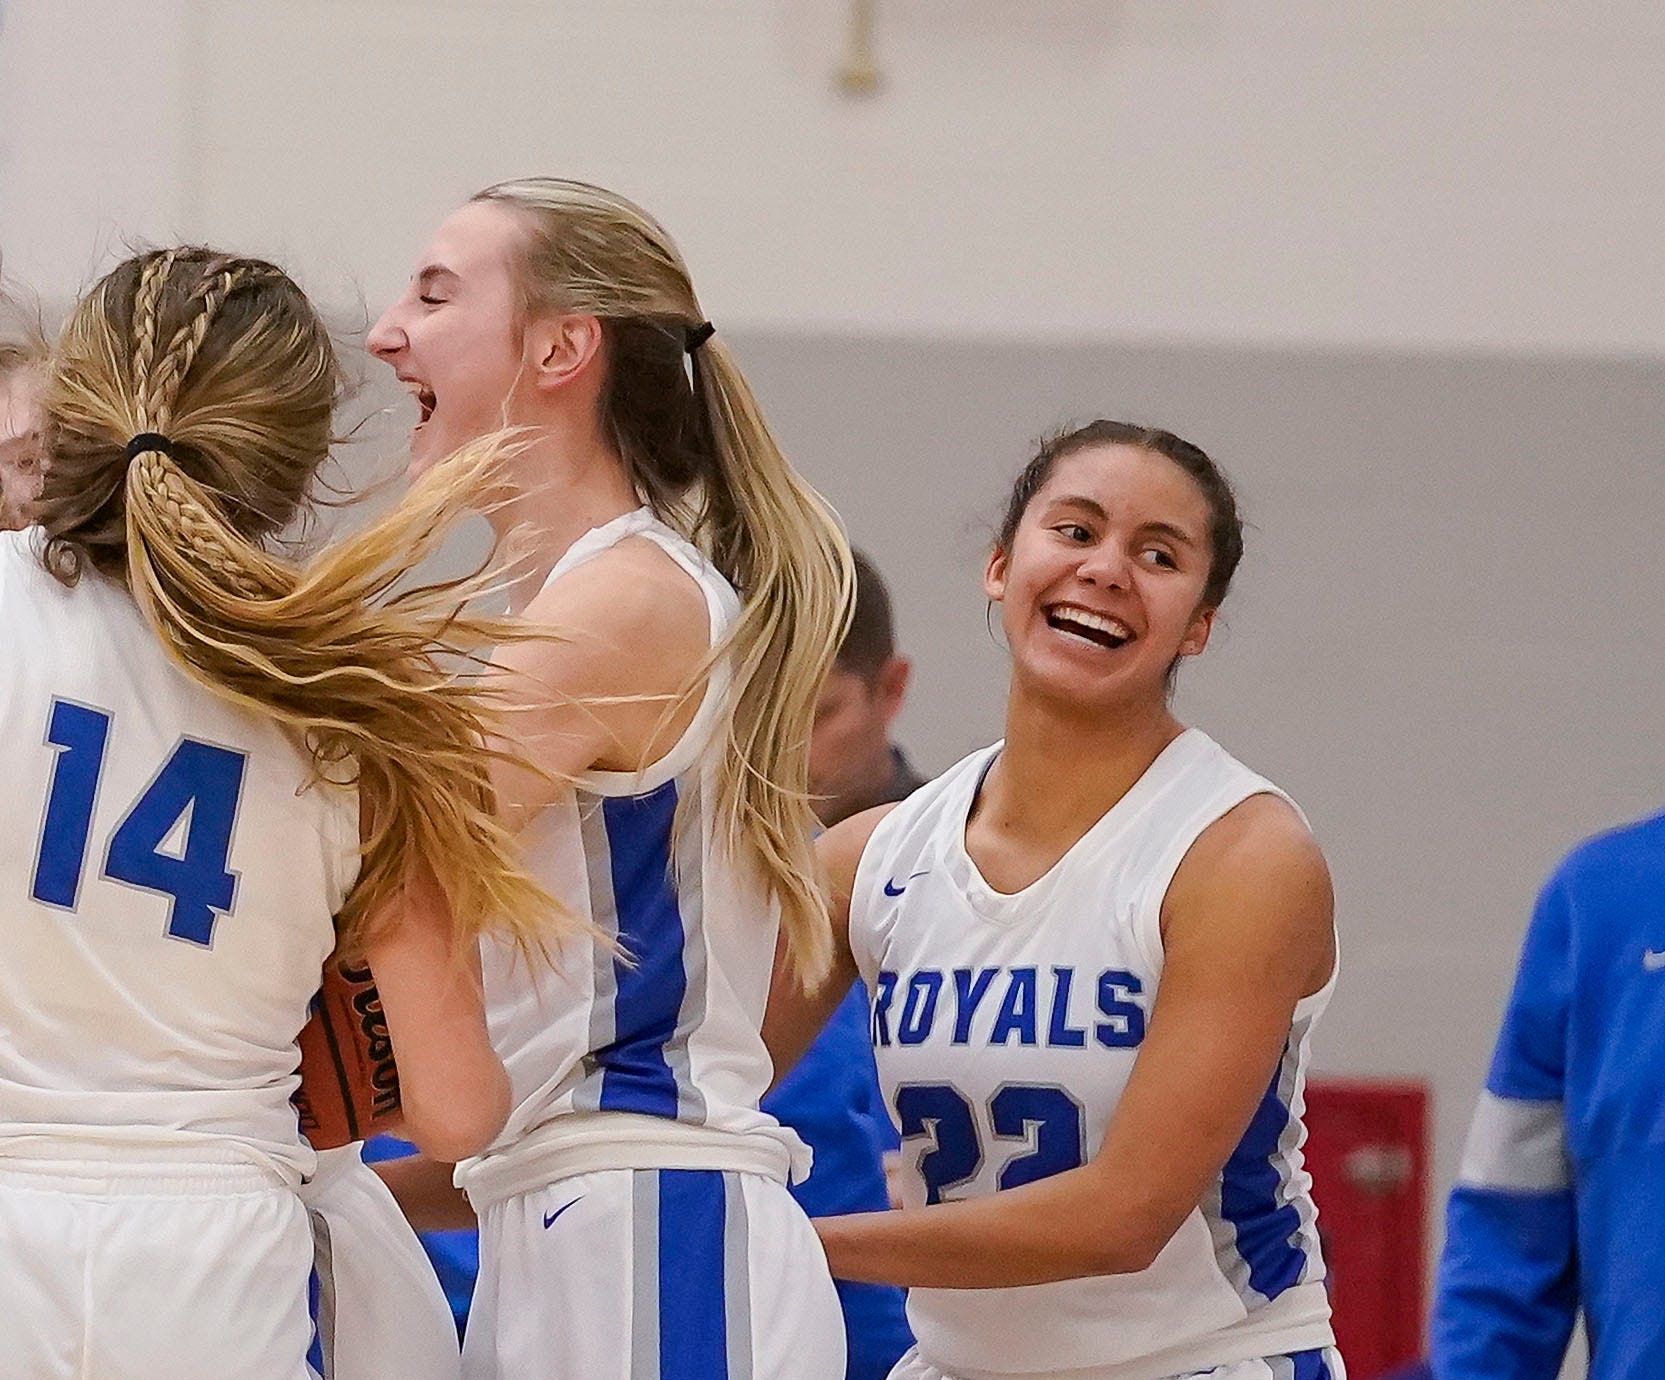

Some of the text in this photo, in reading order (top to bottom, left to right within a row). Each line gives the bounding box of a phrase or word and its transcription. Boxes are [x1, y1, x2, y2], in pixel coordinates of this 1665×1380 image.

[28, 693, 250, 952] 14
[872, 965, 1146, 1050] ROYALS
[892, 1079, 1089, 1206] 22
